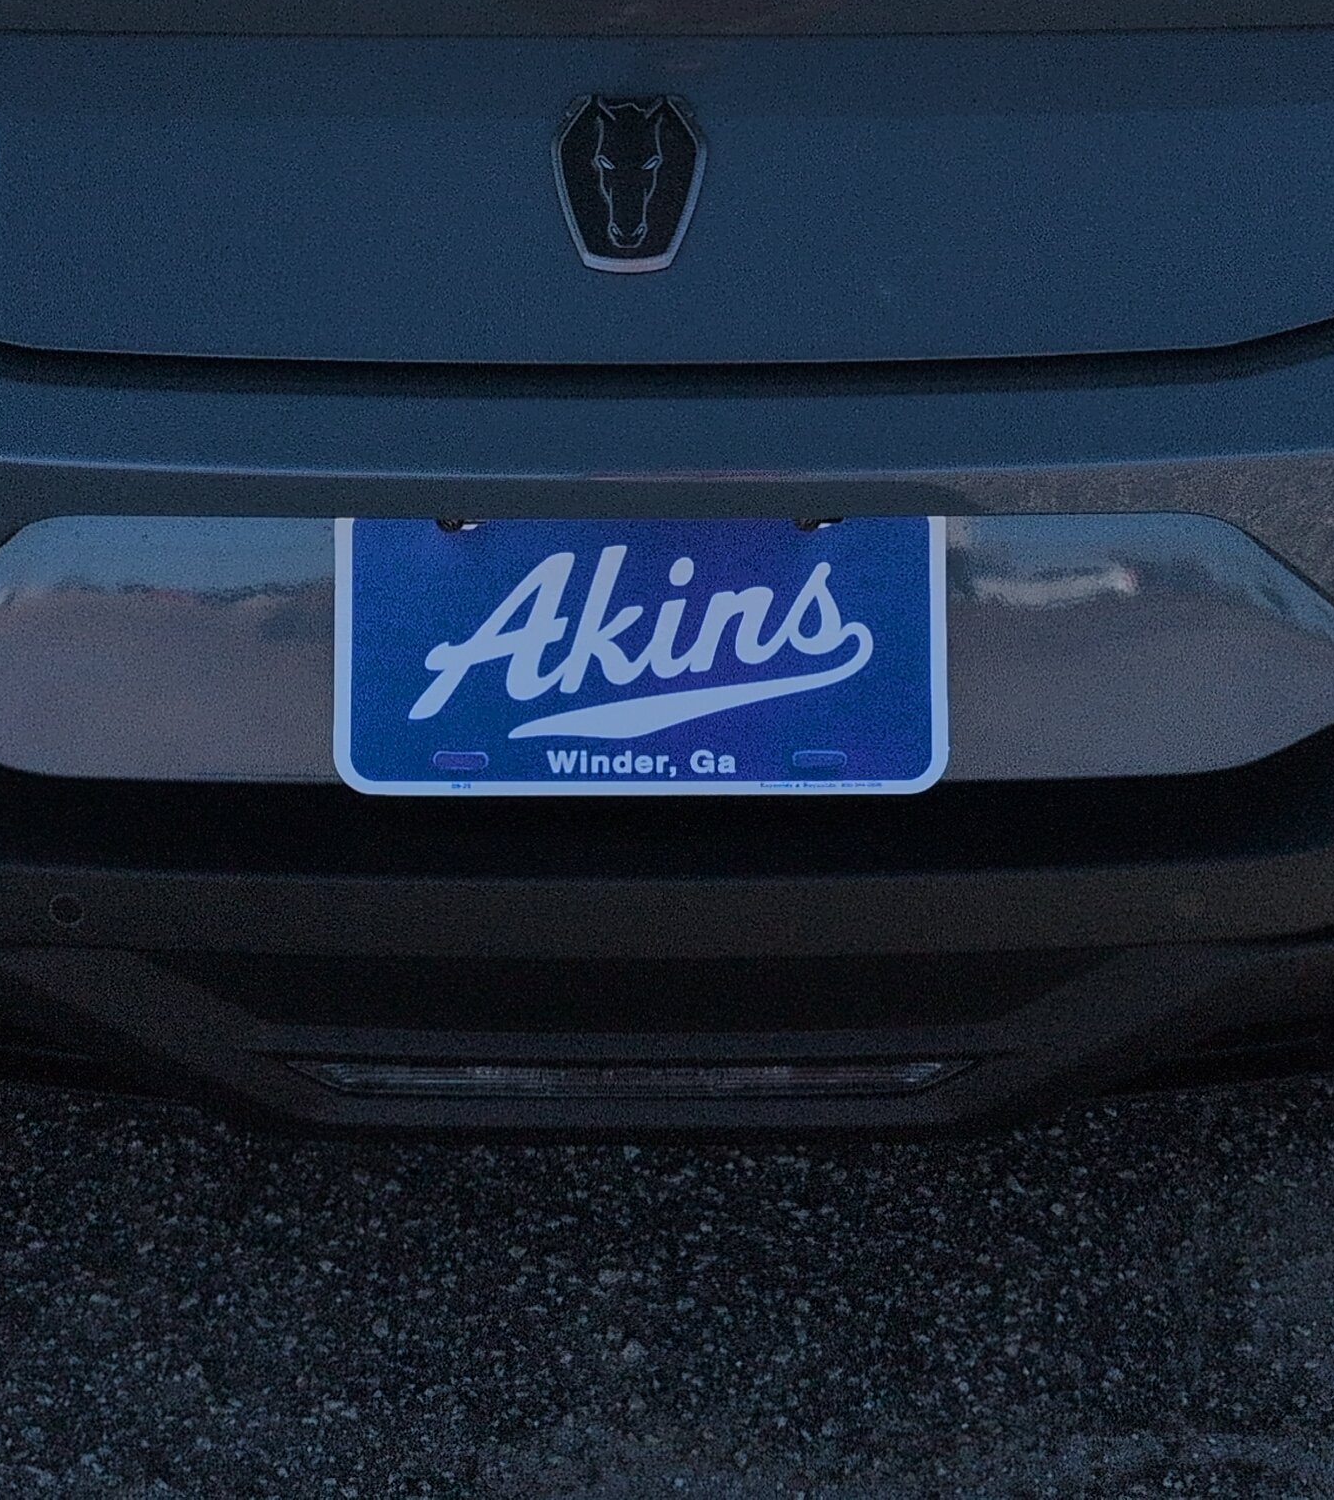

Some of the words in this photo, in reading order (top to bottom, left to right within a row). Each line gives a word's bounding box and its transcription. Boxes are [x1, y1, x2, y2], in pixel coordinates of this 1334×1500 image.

[407, 544, 874, 738] Akins
[545, 749, 678, 778] Winder,
[689, 750, 737, 776] Ga
